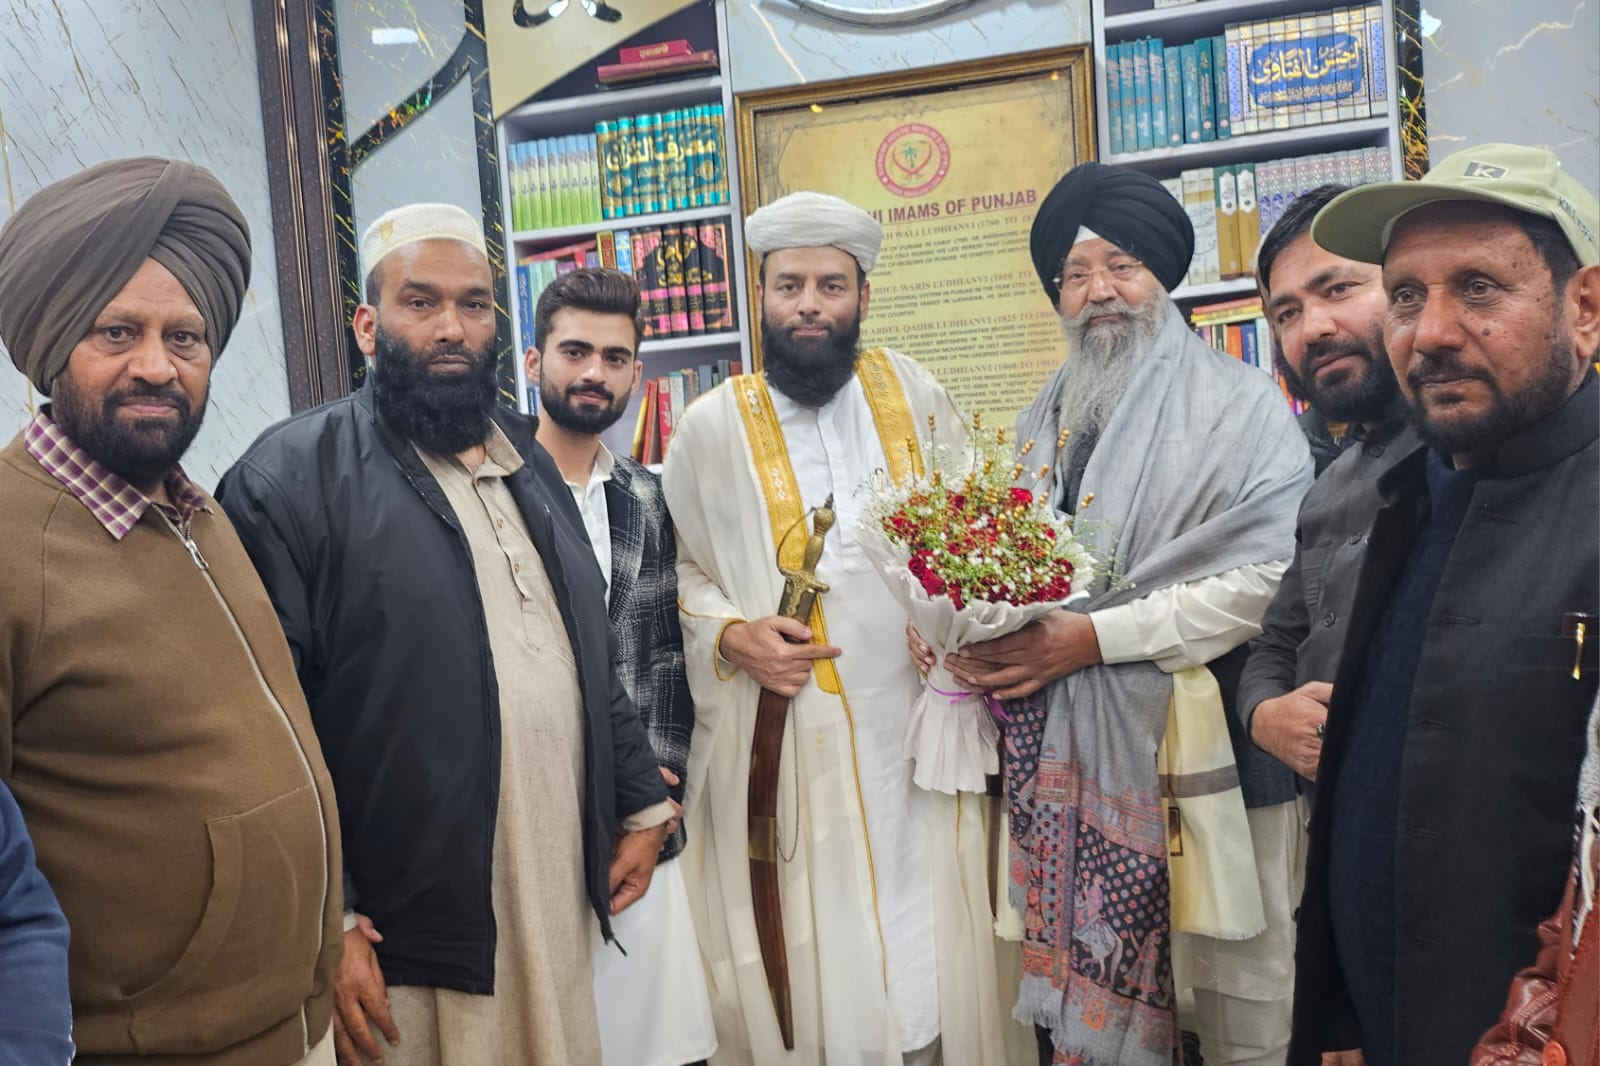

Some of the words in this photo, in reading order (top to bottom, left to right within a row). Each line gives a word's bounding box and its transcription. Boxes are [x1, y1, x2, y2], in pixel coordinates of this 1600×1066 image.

[888, 203, 940, 222] IMAMS
[945, 199, 966, 214] OF
[971, 189, 1037, 211] PUNJAB
[921, 220, 976, 236] LUDHIANVI
[900, 280, 931, 292] WARIS
[932, 275, 988, 289] LUDHIANVI
[870, 324, 901, 336] ABDUL
[903, 321, 934, 333] QADIR
[936, 316, 992, 330] LUDHIANVI
[937, 364, 992, 376] LUDHIANVI
